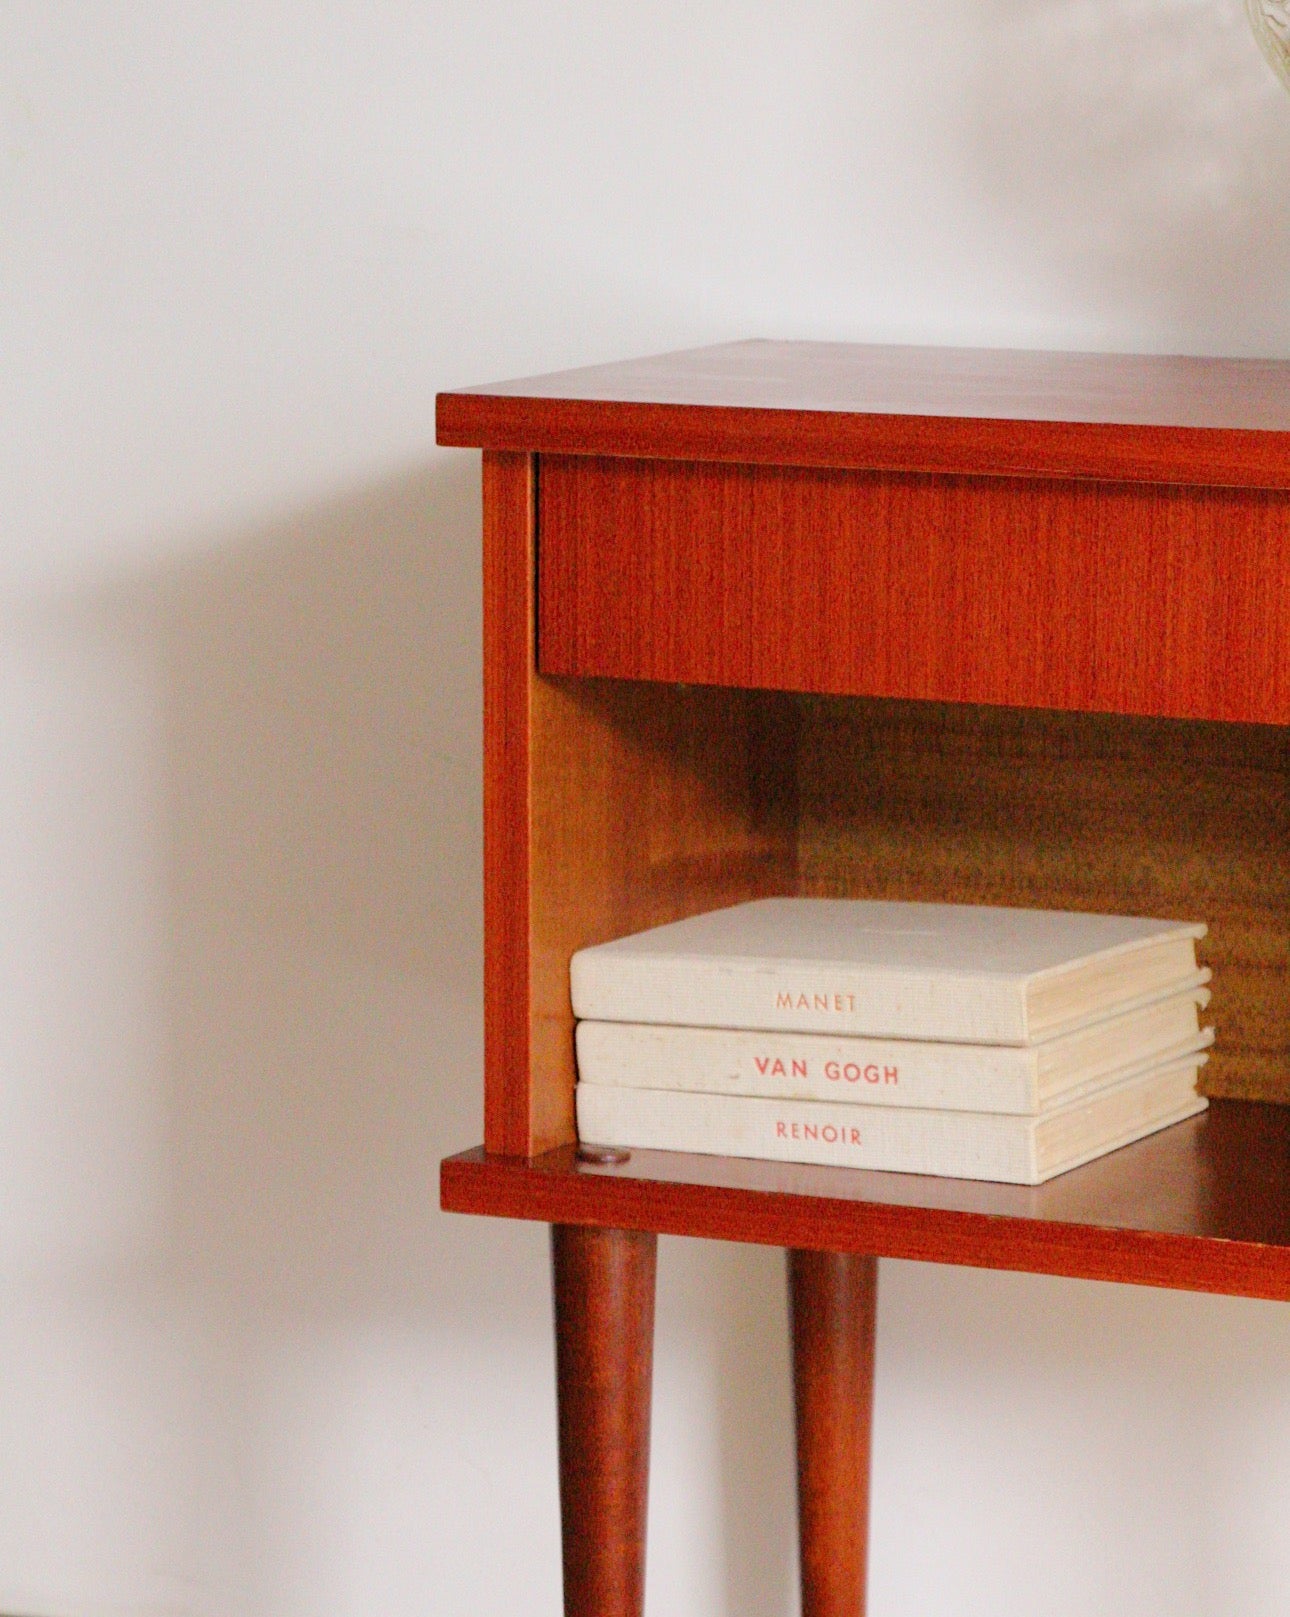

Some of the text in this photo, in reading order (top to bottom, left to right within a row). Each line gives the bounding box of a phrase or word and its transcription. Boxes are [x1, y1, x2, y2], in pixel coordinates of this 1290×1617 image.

[776, 992, 856, 1012] MANET
[754, 1056, 898, 1085] VAN GOGH
[776, 1121, 862, 1146] RENOIR
